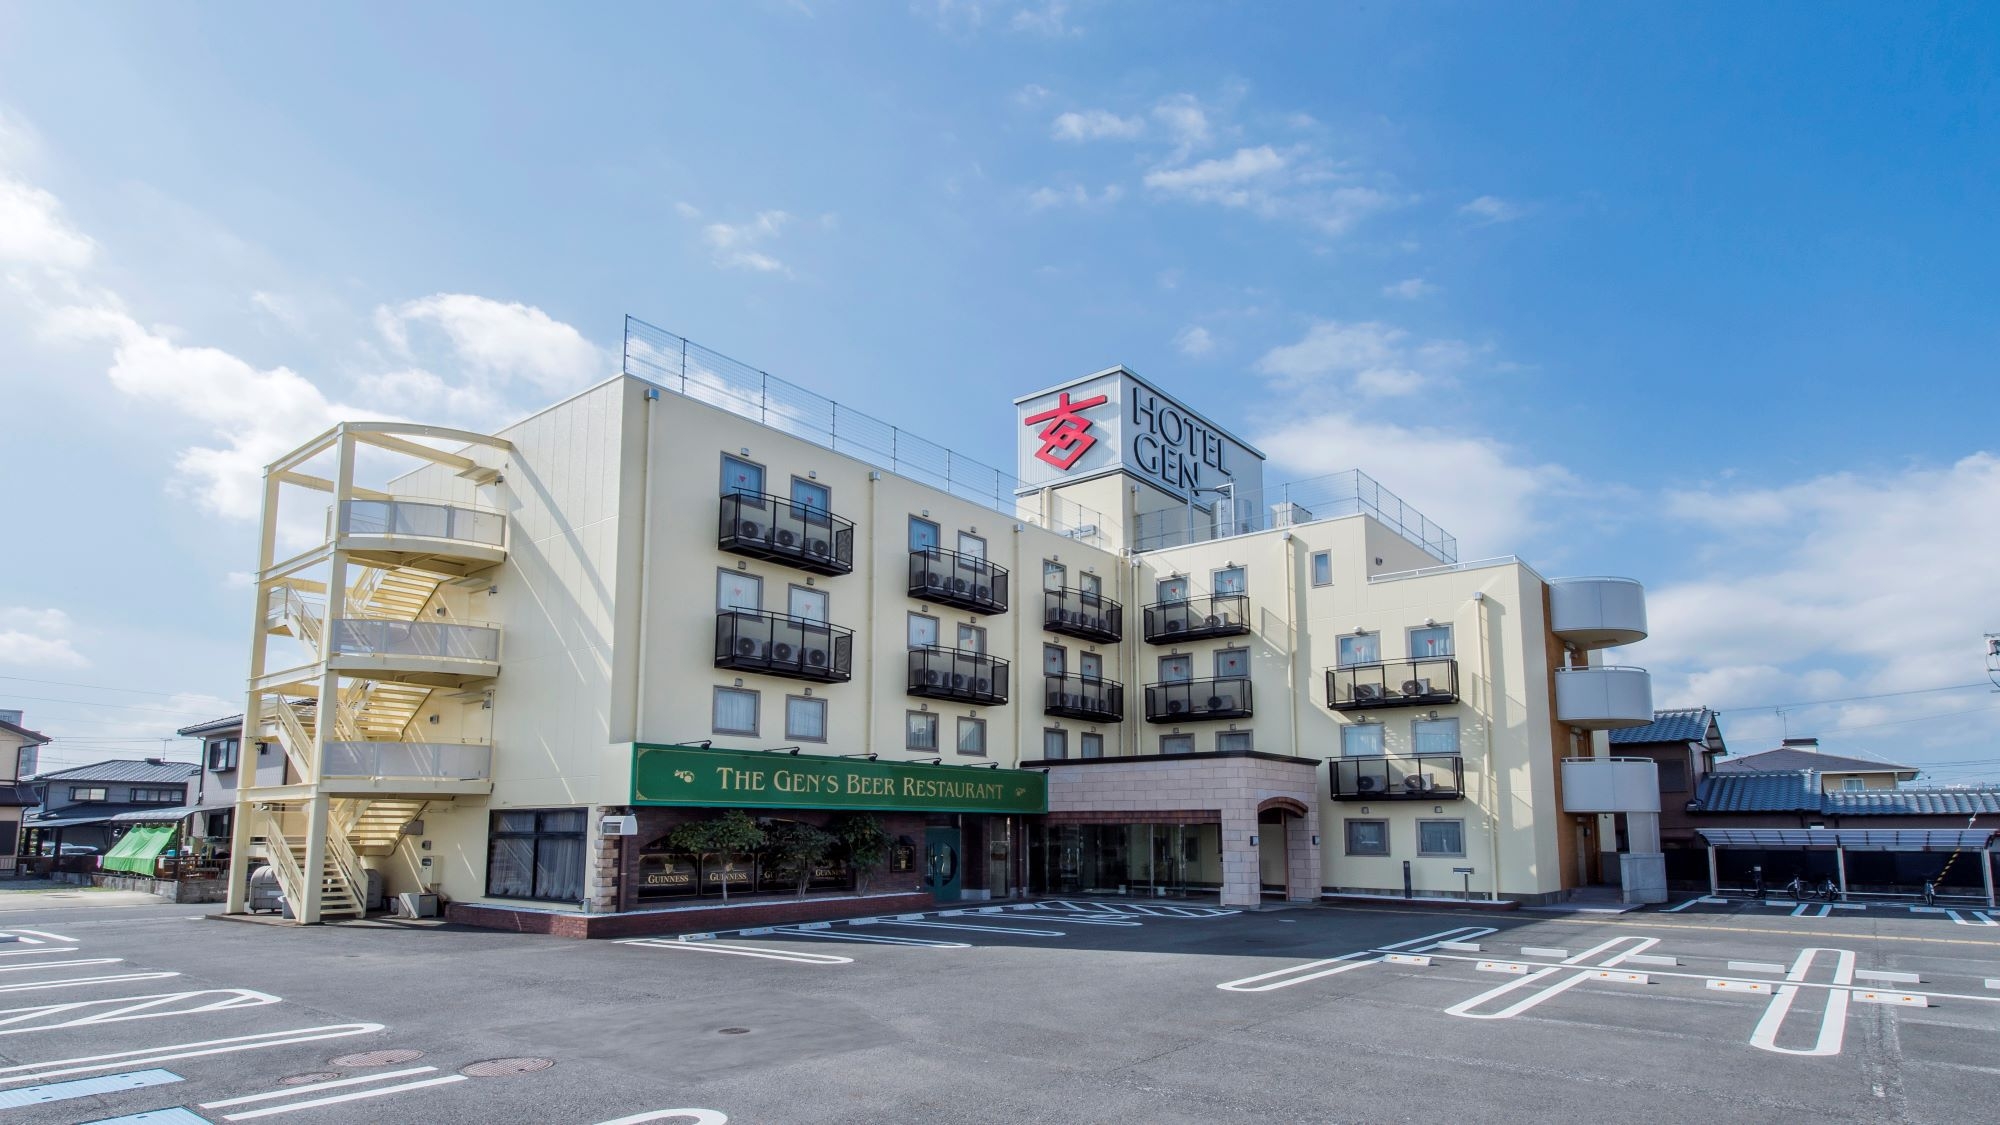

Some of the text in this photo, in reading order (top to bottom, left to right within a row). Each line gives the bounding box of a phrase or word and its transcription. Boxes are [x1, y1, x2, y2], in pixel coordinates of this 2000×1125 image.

[1133, 387, 1232, 476] HOTEL
[1134, 433, 1201, 497] GEN
[716, 767, 1004, 799] THE GEN'S BEER RESTAURANT
[648, 874, 689, 884] GUINNESS
[709, 872, 747, 881] GUINNESS
